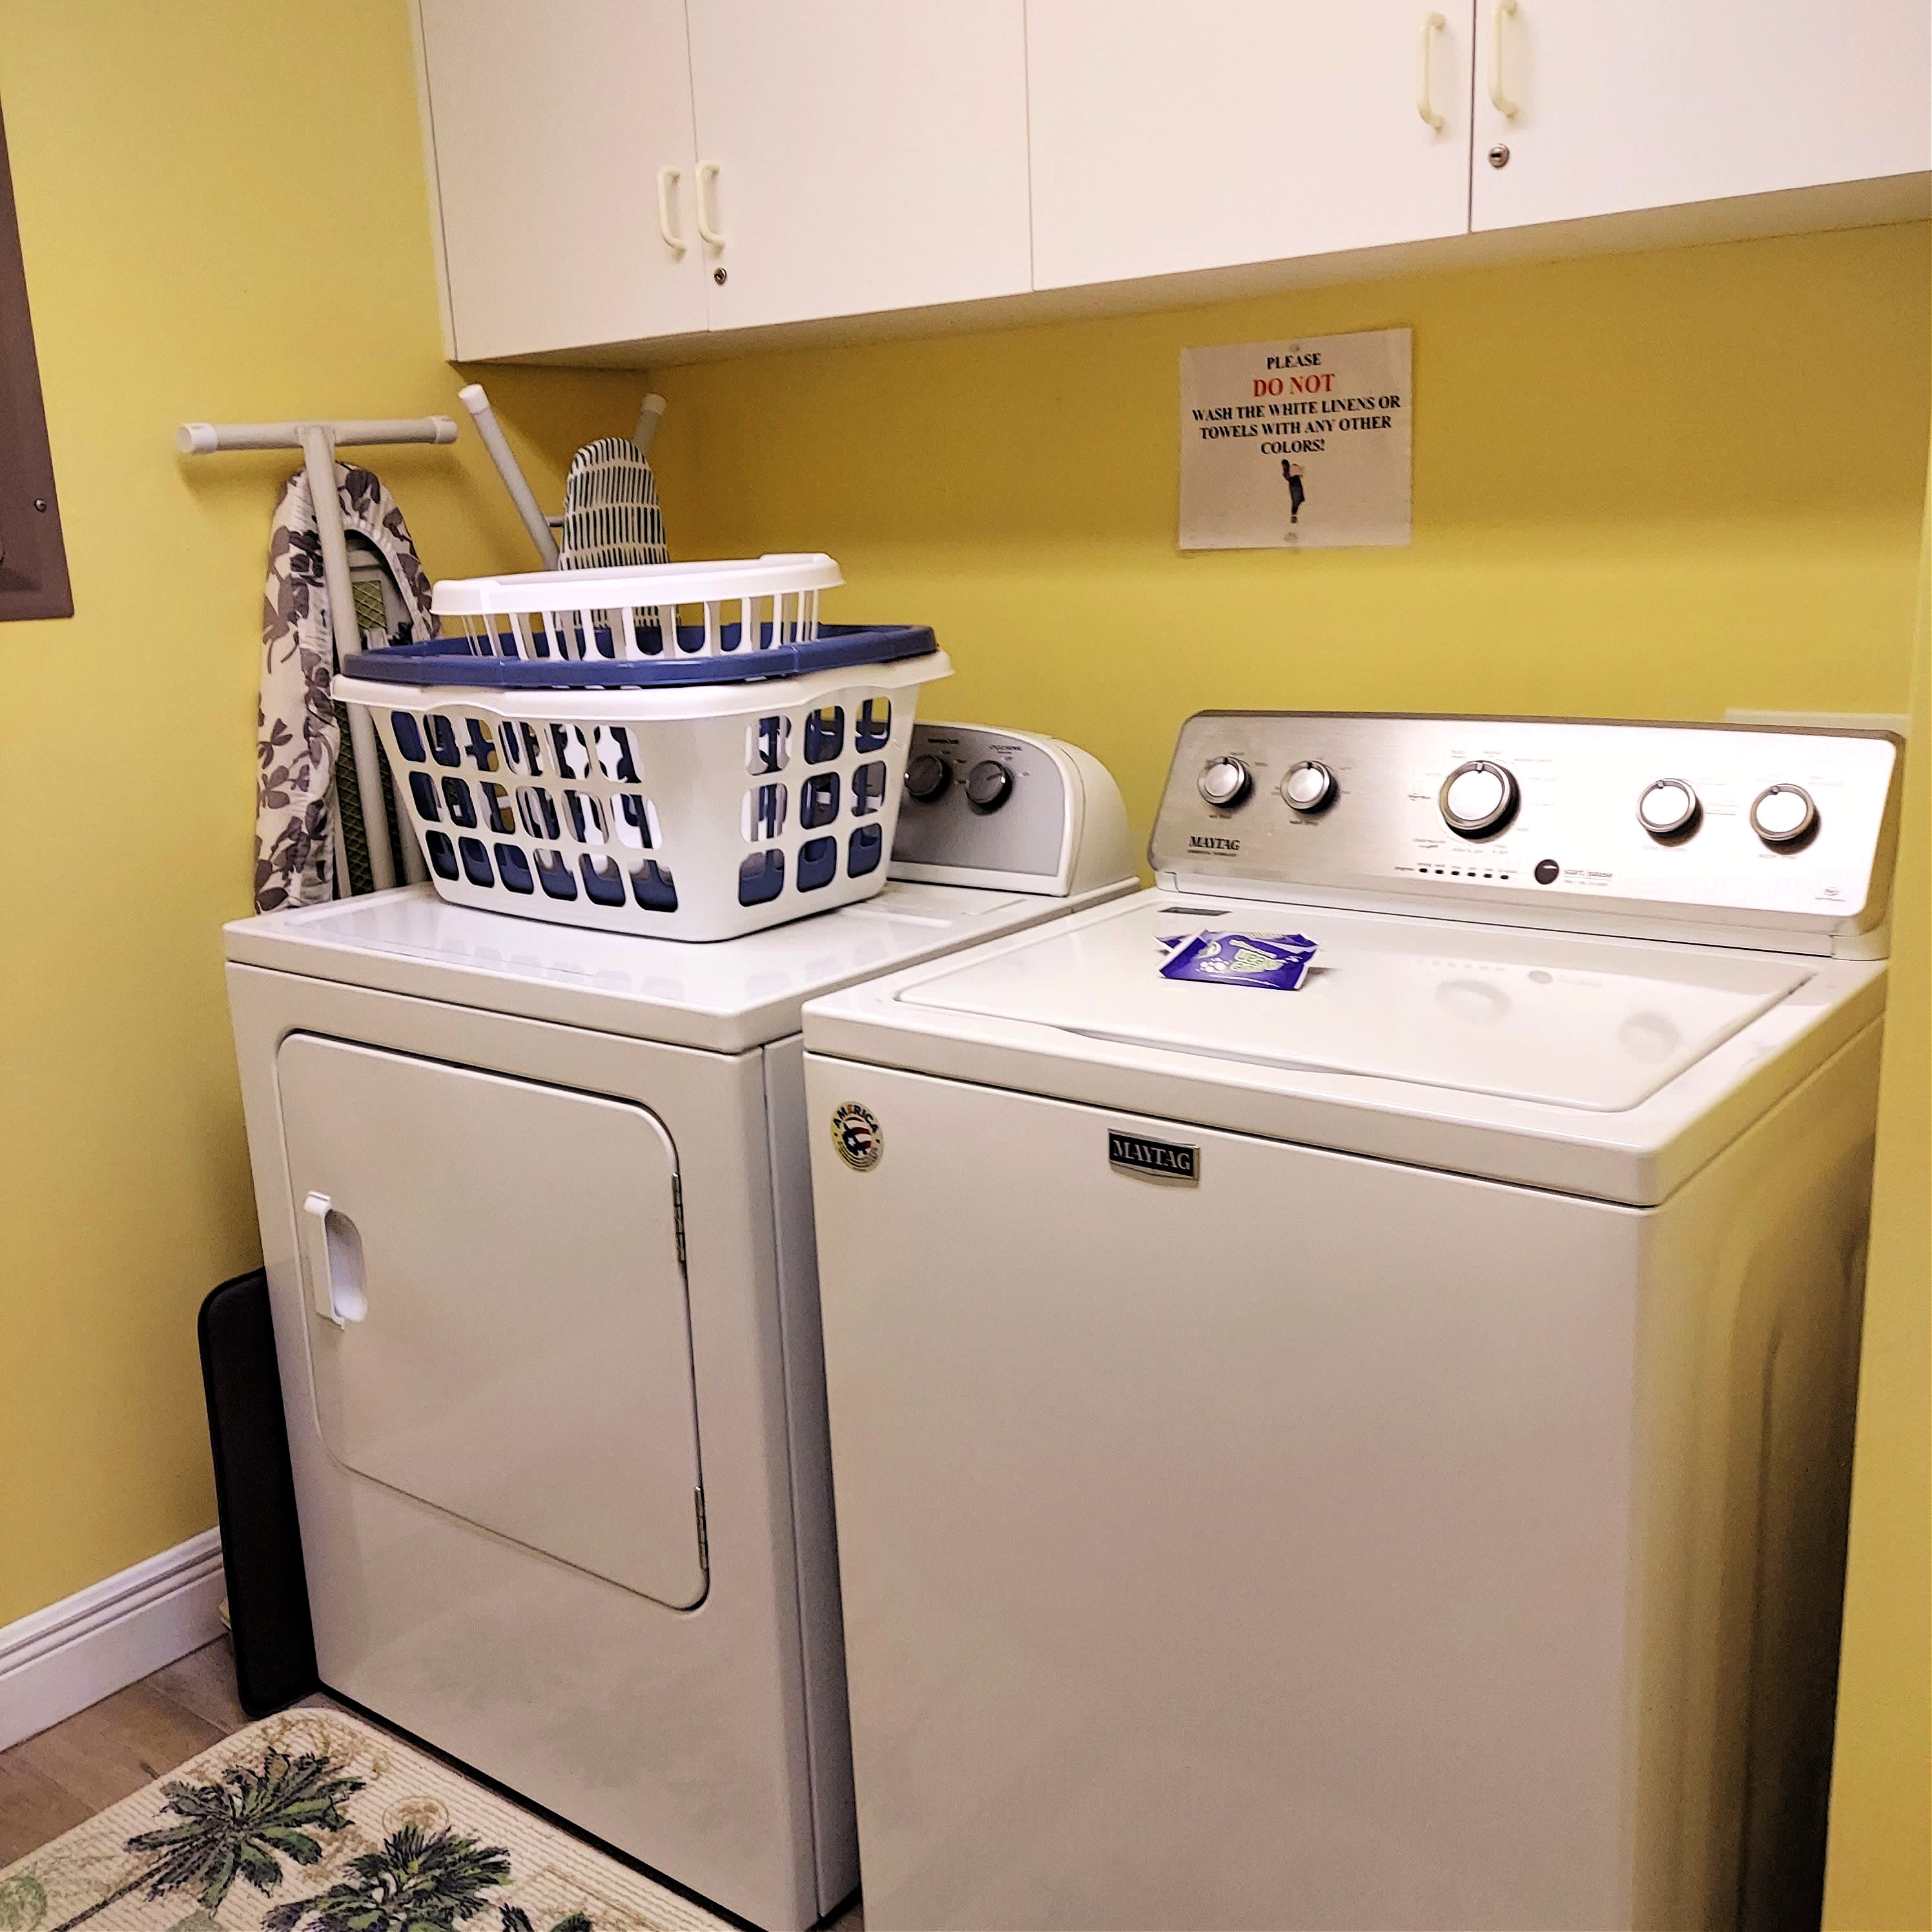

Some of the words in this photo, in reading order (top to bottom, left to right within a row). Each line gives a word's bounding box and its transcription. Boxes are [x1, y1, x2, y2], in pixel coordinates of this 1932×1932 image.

[1267, 353, 1322, 369] PLEASE
[1253, 378, 1284, 398] DO
[1290, 373, 1335, 393] NOT
[1192, 407, 1233, 420] WASH
[1236, 404, 1265, 418] THE
[1268, 402, 1317, 416] WHITE
[1322, 397, 1375, 413] LINENS
[1378, 395, 1401, 408] OR
[1199, 424, 1258, 439] TOWELS
[1262, 422, 1300, 435] WITH
[1304, 419, 1337, 433] ANY
[1339, 416, 1392, 431] OTHER
[1261, 439, 1326, 455] COLORS!
[1189, 836, 1240, 850] MAYTAG
[1113, 1140, 1191, 1170] MAYTAG
